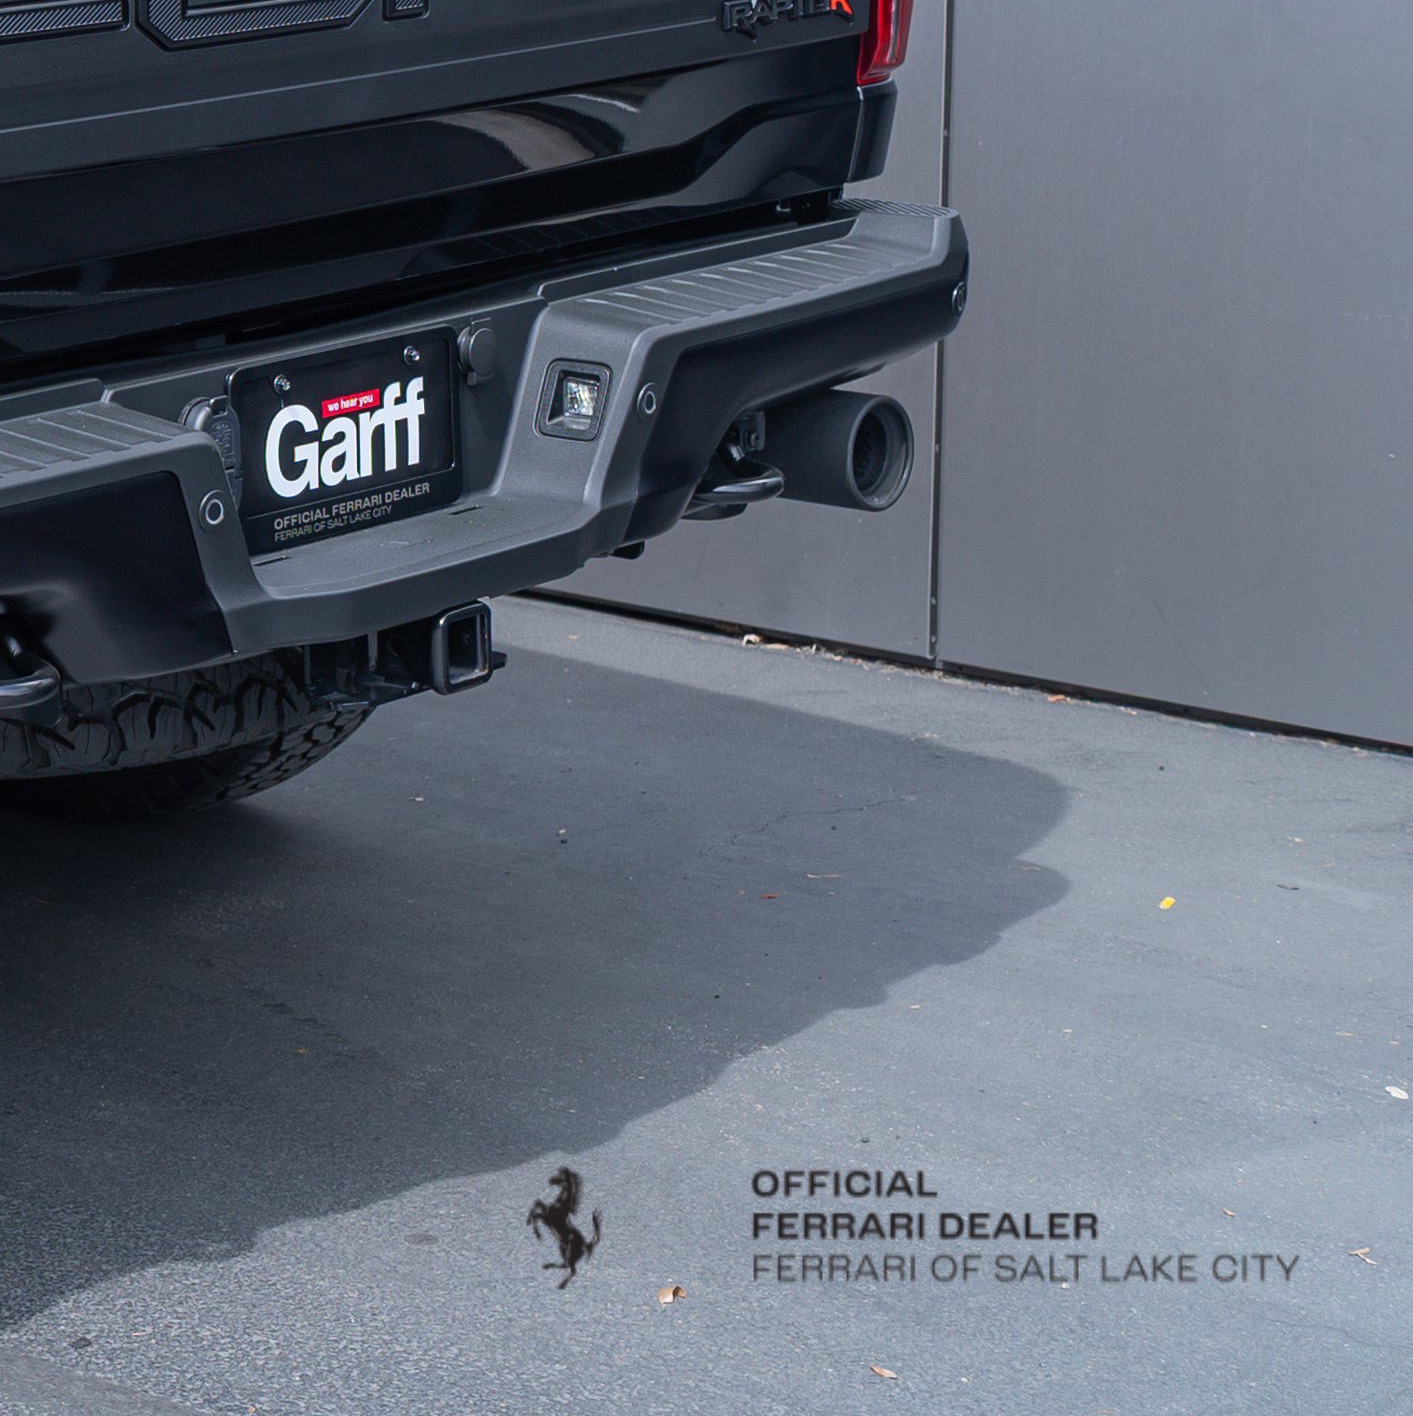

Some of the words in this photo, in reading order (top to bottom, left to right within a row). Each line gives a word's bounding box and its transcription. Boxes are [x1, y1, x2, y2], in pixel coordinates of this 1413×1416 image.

[340, 398, 359, 410] hear
[359, 394, 374, 408] you
[266, 377, 425, 498] Garff
[274, 507, 330, 530] OFFICIAL
[332, 493, 383, 515] FERRARI
[384, 482, 431, 503] DEALER
[274, 526, 313, 542] FERRARI
[313, 522, 326, 533] OF
[327, 516, 349, 530] SALT
[349, 510, 372, 524] LAKE
[373, 505, 392, 518] CITY
